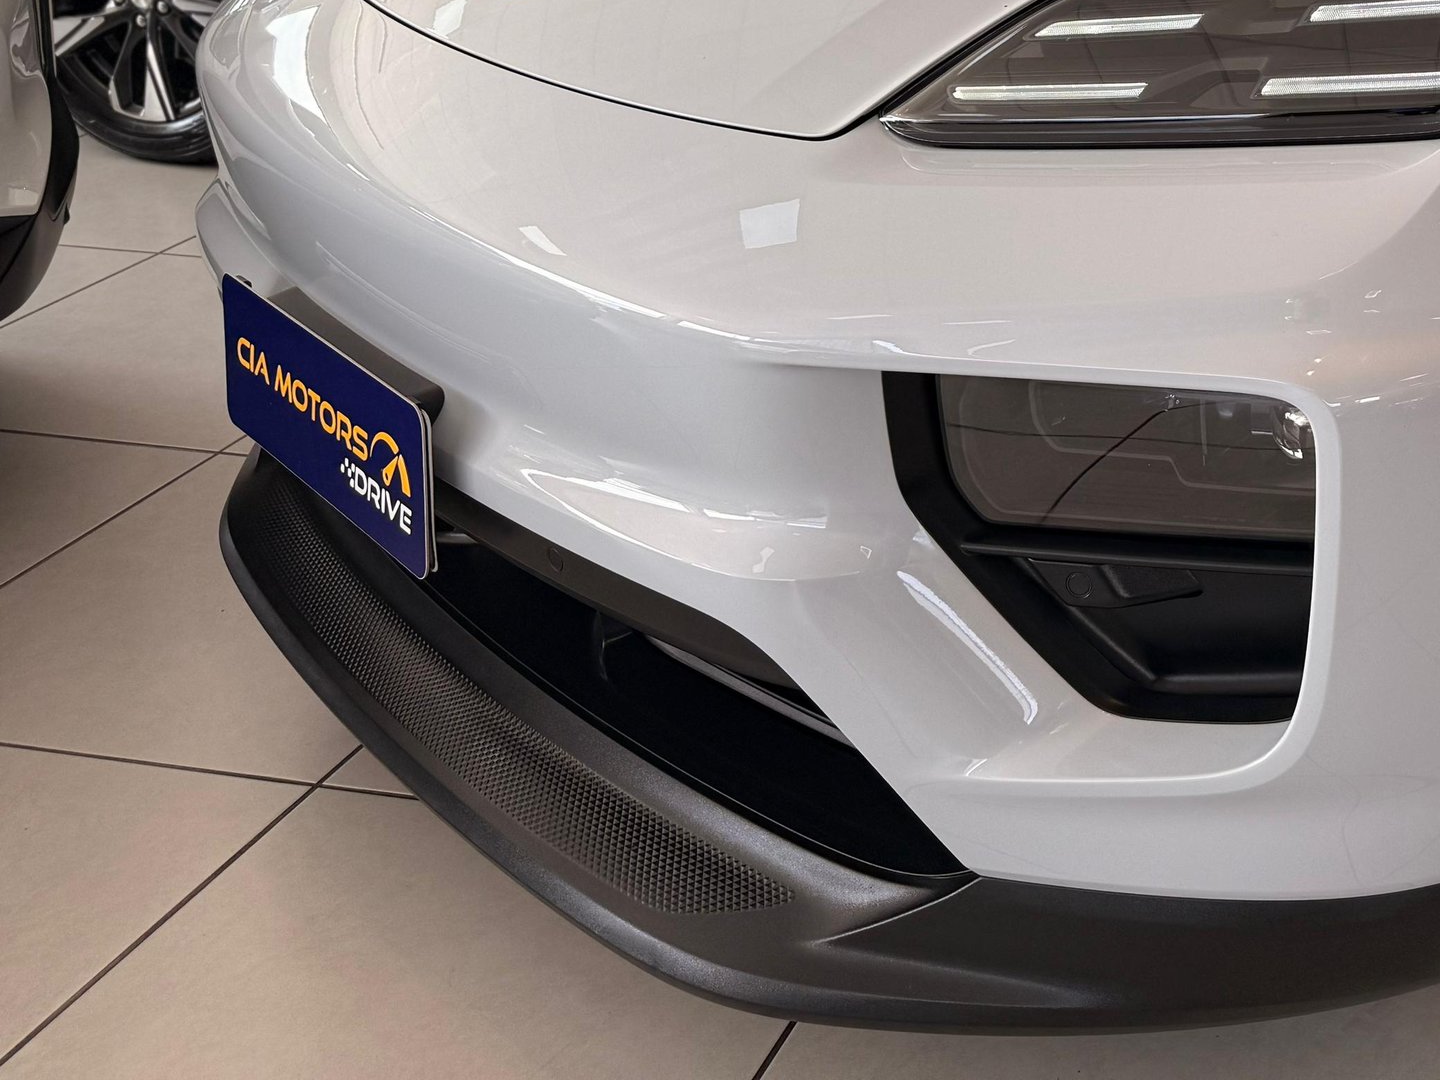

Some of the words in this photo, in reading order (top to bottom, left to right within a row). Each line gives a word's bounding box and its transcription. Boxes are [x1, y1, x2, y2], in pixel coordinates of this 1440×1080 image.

[237, 337, 270, 385] CIA
[274, 364, 369, 461] MOTORS
[354, 466, 413, 535] DRIVE
